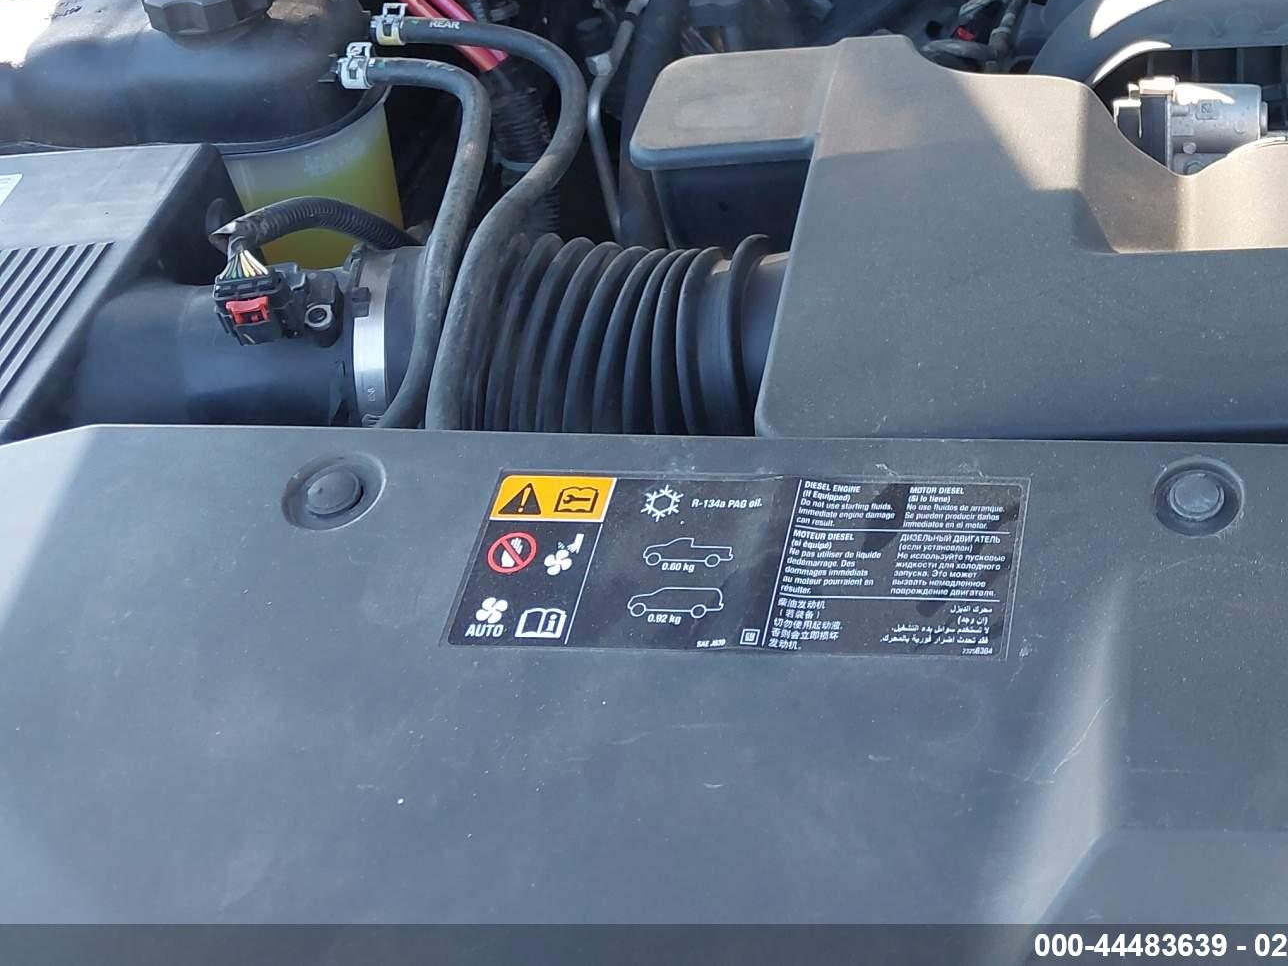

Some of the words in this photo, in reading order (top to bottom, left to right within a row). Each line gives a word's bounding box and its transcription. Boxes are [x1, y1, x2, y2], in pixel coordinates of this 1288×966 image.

[429, 21, 460, 29] REAR
[804, 481, 831, 491] DIESEL
[833, 484, 861, 493] ENGINE
[813, 490, 850, 502] Equipped)
[691, 499, 726, 509] R-134a
[727, 499, 746, 509] PAG
[749, 498, 762, 508] oil.
[801, 498, 810, 506] Do
[812, 500, 824, 508] not
[841, 502, 869, 511] starting
[871, 503, 893, 511] fluids.
[798, 507, 837, 518] Immediate
[839, 512, 864, 520] engine
[865, 512, 895, 520] damage
[916, 512, 943, 520] pueden
[945, 512, 975, 521] producir
[977, 512, 1000, 521] daños
[812, 518, 835, 527] result.
[793, 530, 826, 540] MOTEUR
[900, 534, 951, 542] ДИЗЕЛЬНЫЙ
[952, 535, 1001, 543] ДВИГАТЕЛЬ
[791, 539, 801, 547] (si
[803, 540, 832, 551] équipé)
[899, 543, 922, 551] (если
[923, 544, 973, 552] установлен)
[789, 547, 800, 555] Ne
[801, 550, 815, 558] pas
[817, 550, 842, 558] utiliser
[856, 551, 881, 559] liquide
[910, 553, 963, 561] используйте
[661, 563, 681, 571] 0.60
[683, 563, 695, 573] kg
[896, 561, 937, 569] жидкости
[956, 563, 1001, 571] холодного
[785, 566, 827, 577] dommages
[829, 568, 868, 576] immédiats
[823, 578, 862, 586] pourraient
[929, 579, 986, 588] немедленное
[781, 584, 811, 594] résulter.
[890, 588, 948, 596] повреждение
[949, 589, 996, 597] двигателя.
[777, 598, 825, 609] 柴油发动机
[950, 605, 971, 613] الديزل
[973, 605, 992, 613] محرك
[647, 614, 668, 623] 0.92
[669, 615, 681, 625] kg
[465, 624, 504, 637] AUTO
[771, 628, 839, 640] 否则会立即损坏
[934, 625, 955, 633] سوائل
[957, 626, 982, 634] تستخدم
[696, 640, 710, 648] SAE
[912, 634, 931, 644] فورية
[978, 636, 988, 644] فقد
